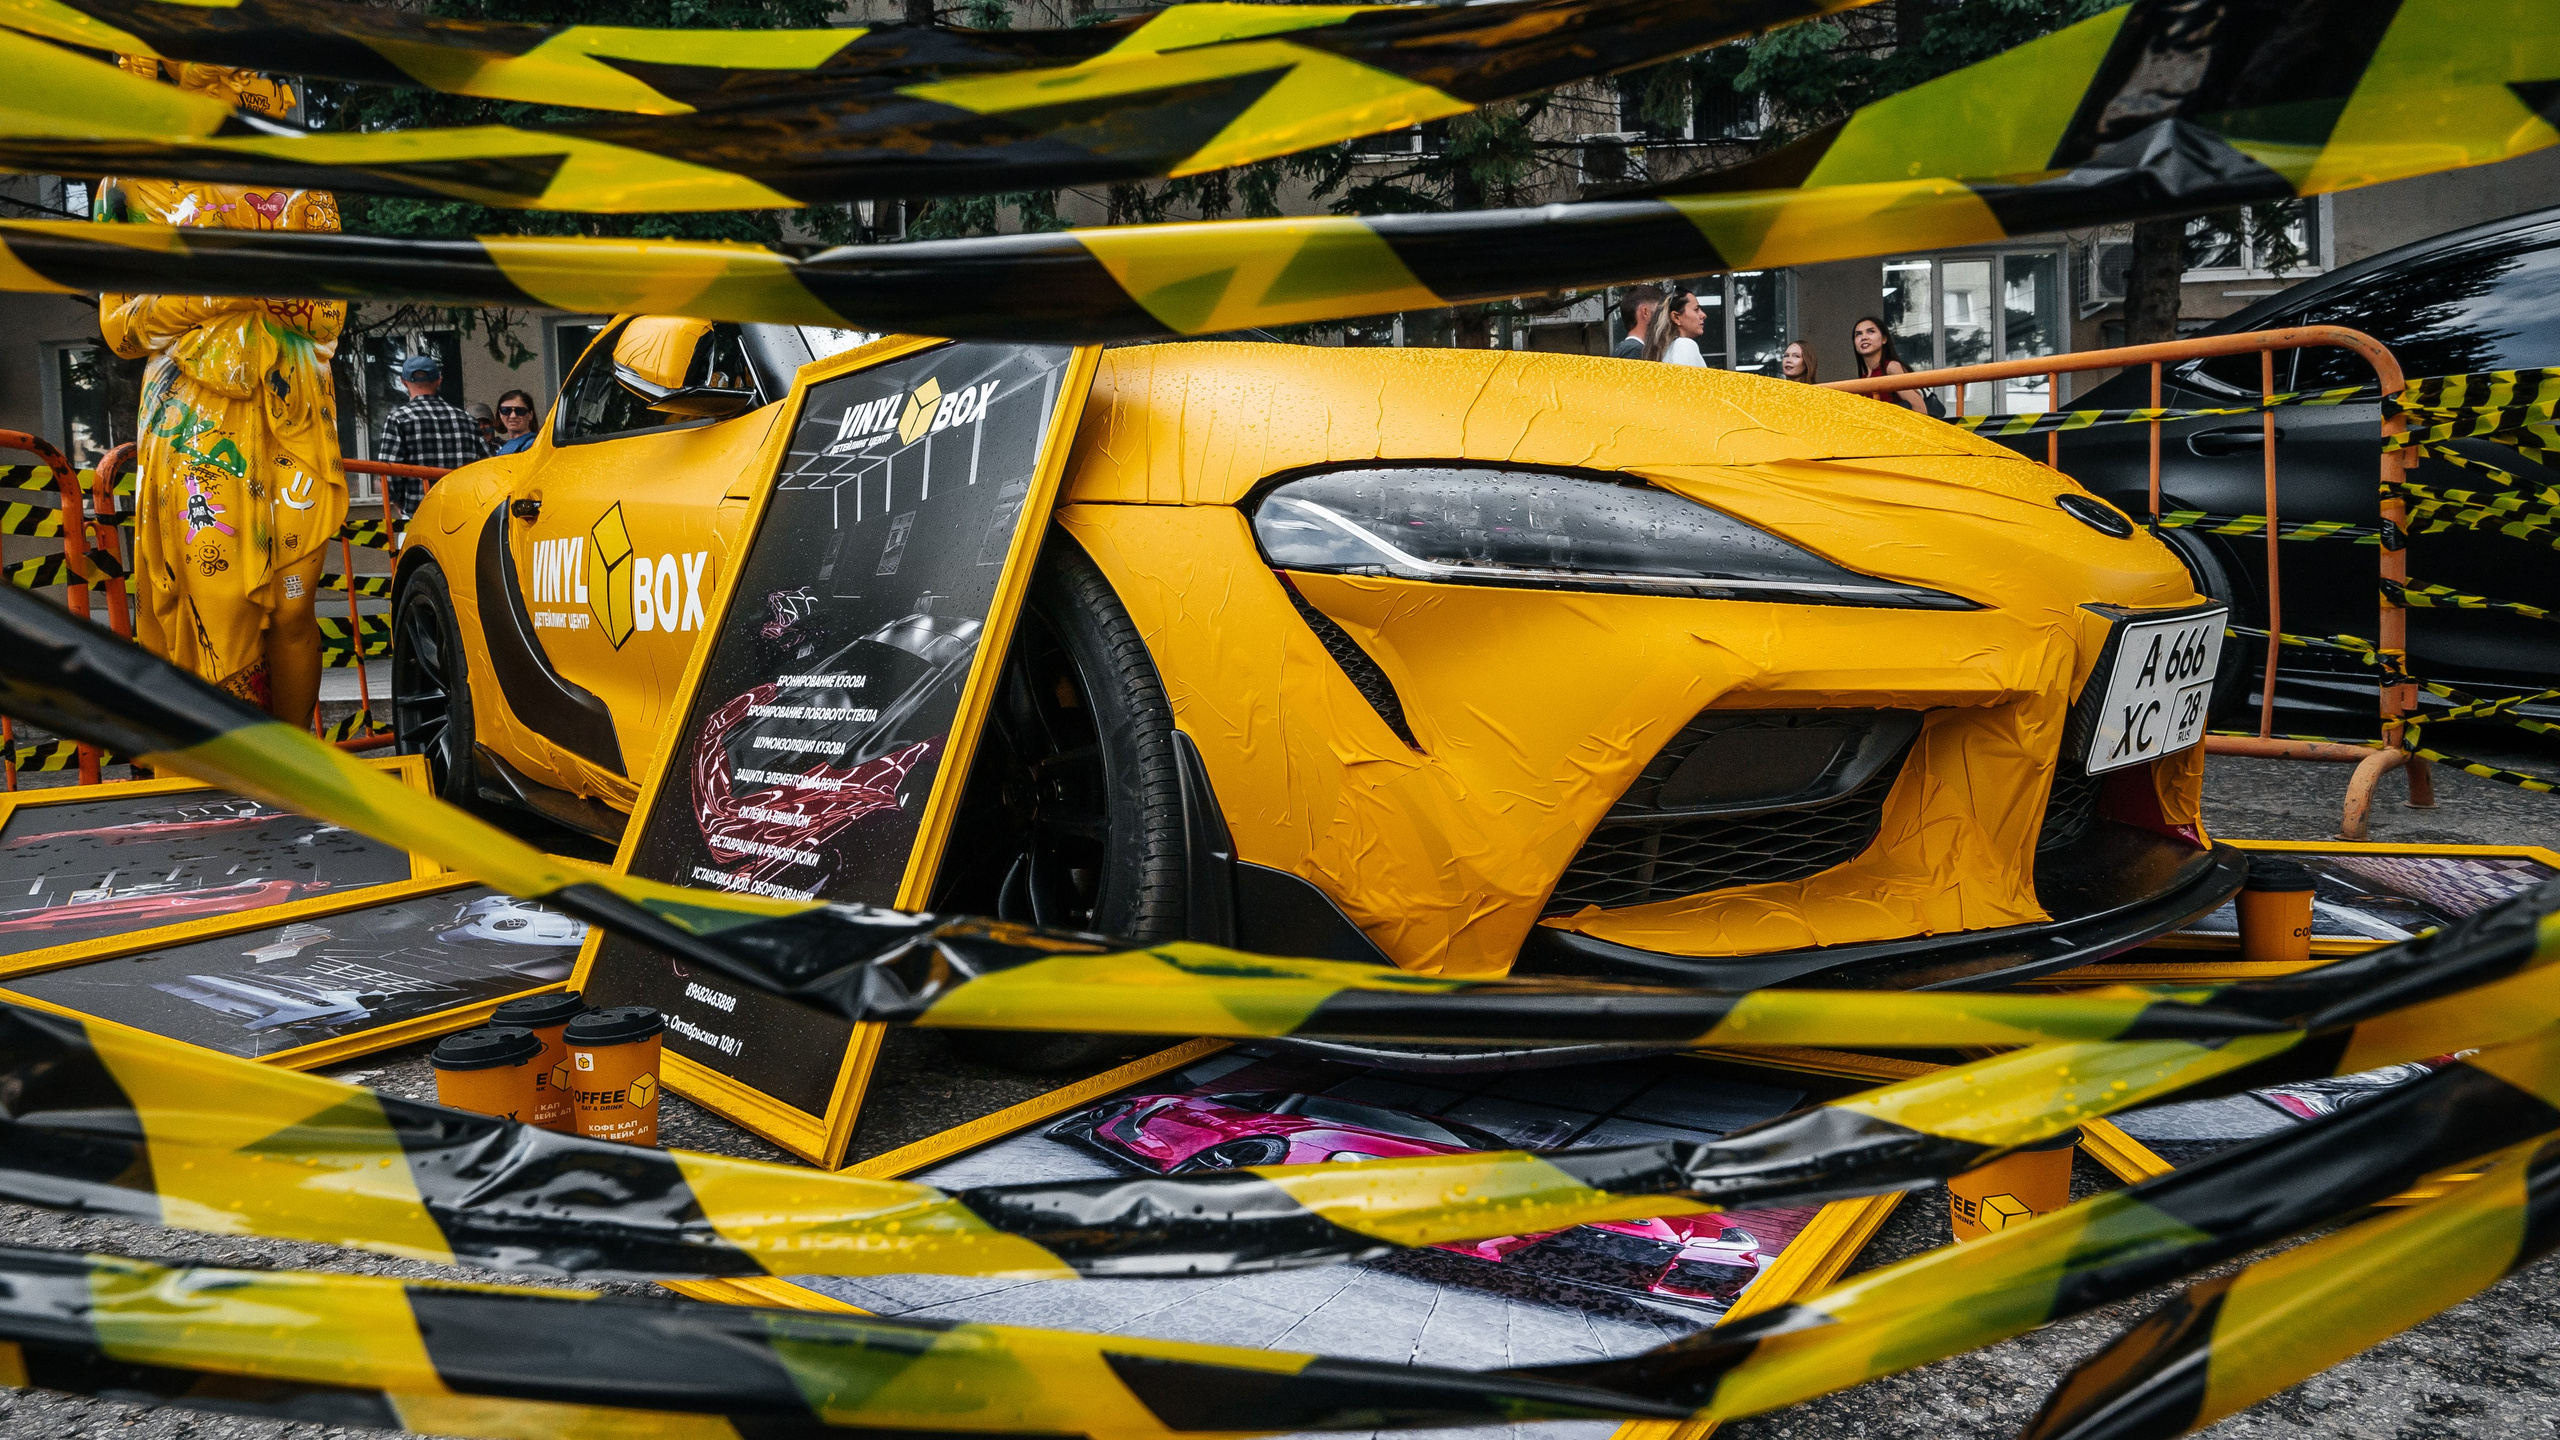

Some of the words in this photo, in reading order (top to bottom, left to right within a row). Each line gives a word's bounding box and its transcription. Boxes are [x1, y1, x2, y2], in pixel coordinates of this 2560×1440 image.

[257, 203, 278, 212] LOVE
[836, 393, 904, 441] VINYL
[930, 379, 1001, 432] BOX
[829, 438, 869, 456] ДЕТЕЙЛИНГ
[867, 433, 893, 448] ЦЕНТР
[533, 537, 588, 604] VINYL
[633, 551, 708, 633] BOX
[534, 609, 567, 630] ДЕТЕЙЛИНГ
[568, 613, 590, 632] ЦЕНТР
[2165, 624, 2209, 683] 666
[776, 675, 837, 688] БРОНИРОВАНИЕ
[835, 675, 867, 688] КУЗОВА
[747, 705, 804, 719] БРОНИРОВАНИЕ
[802, 707, 846, 721] ЛОБОВОГО
[845, 708, 878, 722] СТЕКЛА
[2178, 691, 2202, 730] 28
[753, 736, 816, 754] ШУМОИЗОЛЯЦИЯ
[814, 741, 847, 755] КУЗОВА
[2176, 729, 2191, 743] RUS
[735, 768, 765, 783] ЗАЩИТА
[808, 777, 842, 792] АЛОНА
[738, 805, 774, 822] ОКЛЕЙКА
[773, 810, 812, 828] ВИНИЛОМ
[709, 834, 758, 855] РЕСТАВРАЦИЯ
[756, 843, 764, 855] И
[762, 844, 797, 861] РЕМОНТ
[795, 850, 821, 867] КОЖИ
[691, 866, 733, 887] УСТАНОВКА
[730, 876, 750, 891] ДОП.
[750, 880, 815, 903] ОБОРУДОВАНИЯ
[685, 982, 737, 1012] 89682463888
[670, 1014, 720, 1047] Октябрьская
[718, 1034, 743, 1056] 108/1
[575, 1089, 626, 1105] OFFEE
[588, 1123, 615, 1132] КОФЕ
[618, 1120, 638, 1130] КАП
[610, 1130, 635, 1140] ВЕЙК
[638, 1125, 649, 1134] АП
[1954, 1211, 1975, 1227] DRINK
